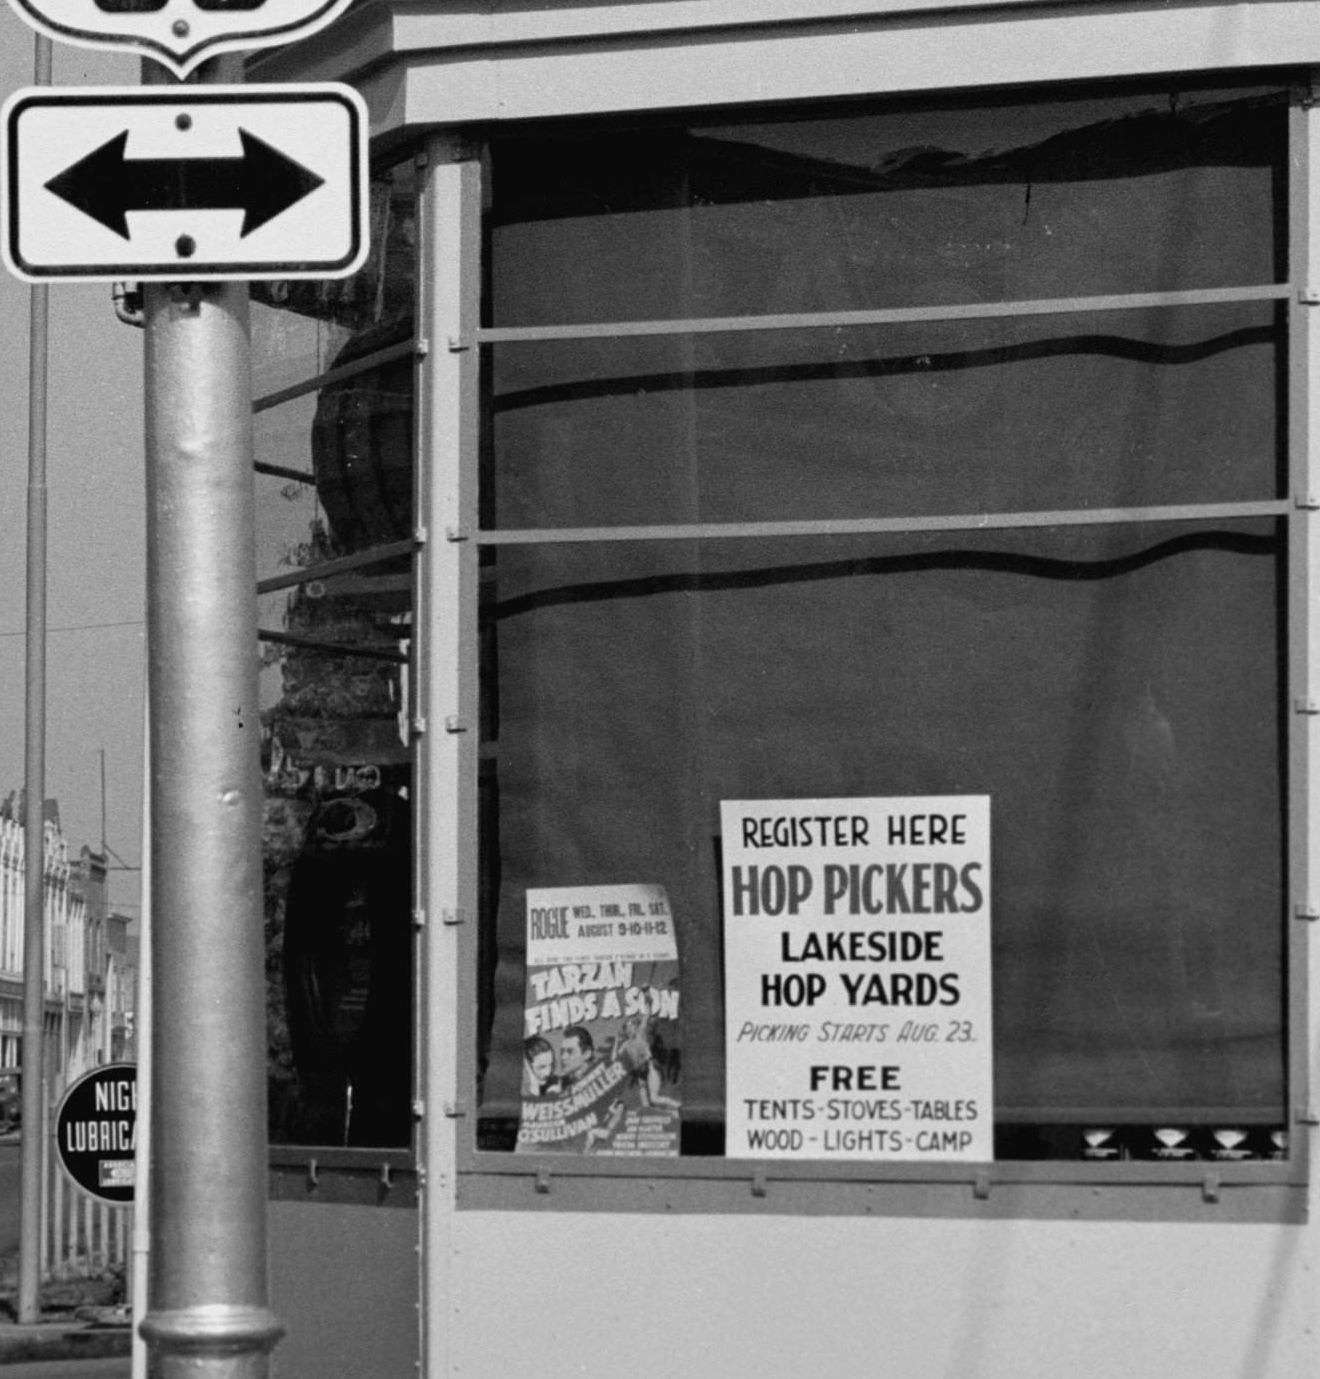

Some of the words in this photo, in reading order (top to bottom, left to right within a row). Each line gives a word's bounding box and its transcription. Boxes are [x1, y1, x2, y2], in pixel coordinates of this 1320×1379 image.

[741, 815, 870, 849] REGISTER
[888, 814, 967, 846] HERE
[732, 864, 814, 917] HOP
[823, 861, 984, 916] PICKERS
[578, 923, 613, 938] AUGUST
[781, 931, 944, 963] LAKESIDE
[530, 962, 633, 1002] TARZAN
[761, 973, 827, 1007] HOP
[839, 972, 961, 1007] YARDS
[525, 992, 598, 1038] FINDS
[601, 990, 622, 1019] A
[625, 985, 679, 1020] SON
[737, 1021, 810, 1043] PICKING
[817, 1021, 891, 1043] STARTS
[810, 1065, 902, 1092] FREE
